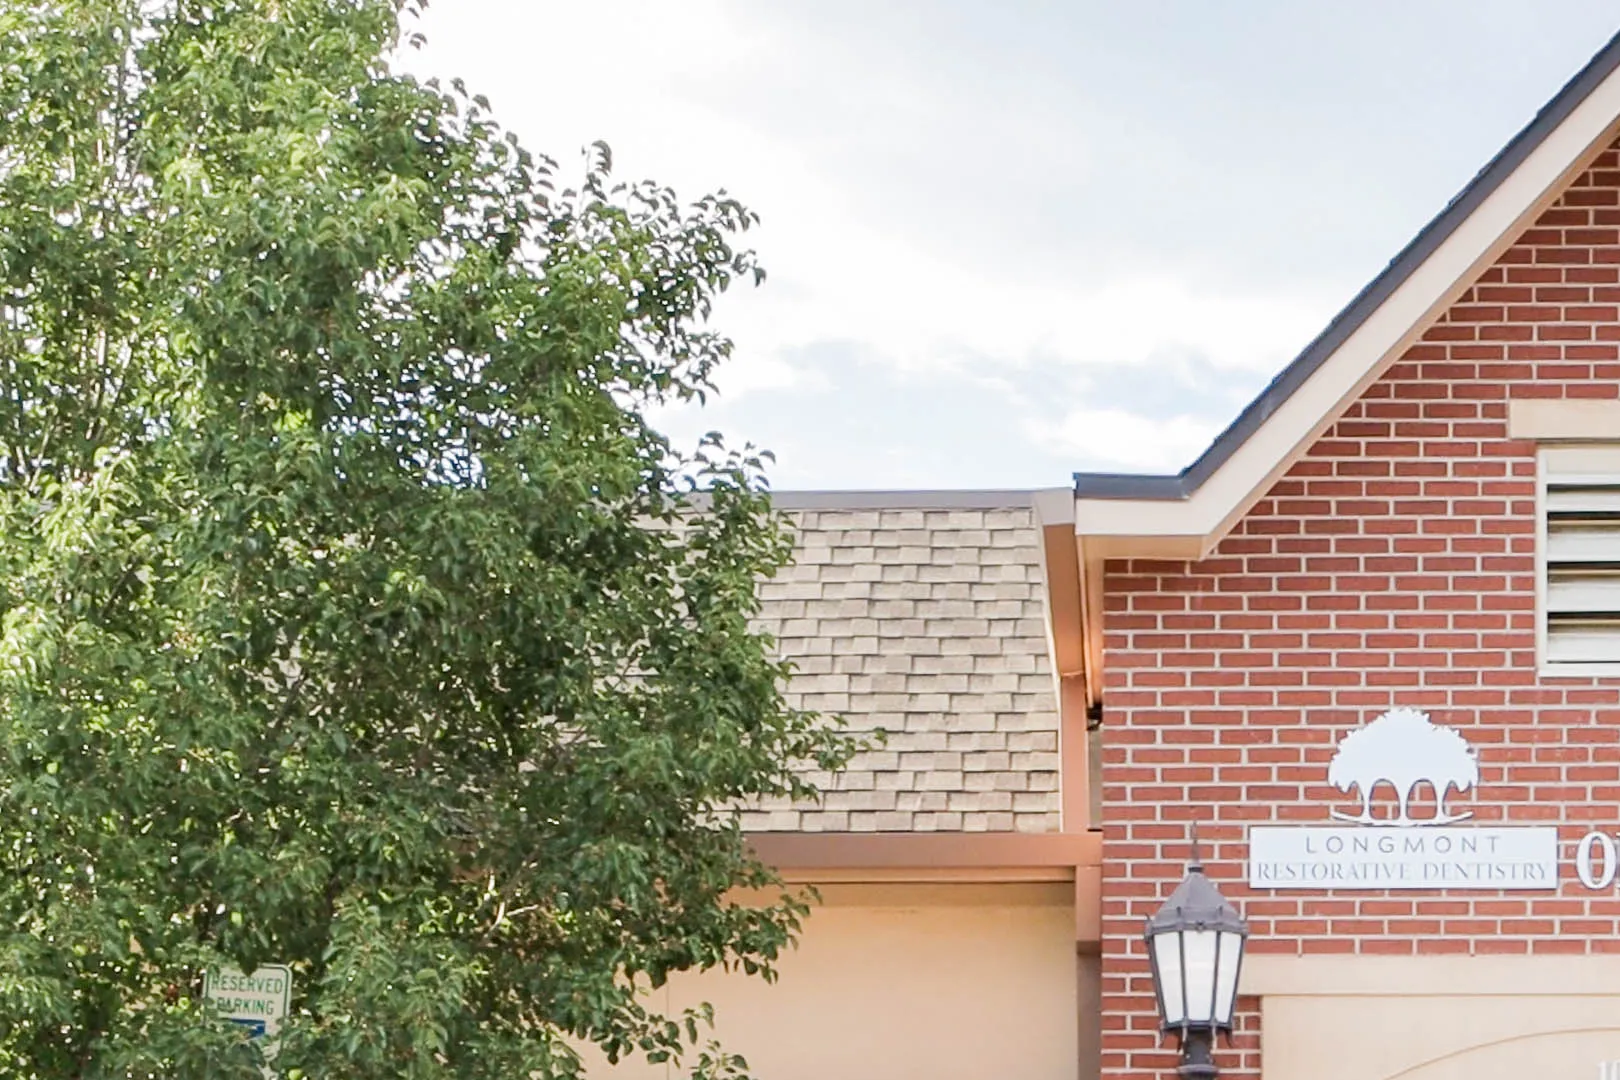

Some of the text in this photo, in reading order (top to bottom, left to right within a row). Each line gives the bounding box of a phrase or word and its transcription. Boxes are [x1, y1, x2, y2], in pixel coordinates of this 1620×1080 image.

[1305, 836, 1501, 854] LONGMONT
[1257, 862, 1548, 880] RESTORATIVE DENTISTRY
[211, 975, 283, 994] RESERVED
[217, 997, 275, 1015] PARKING
